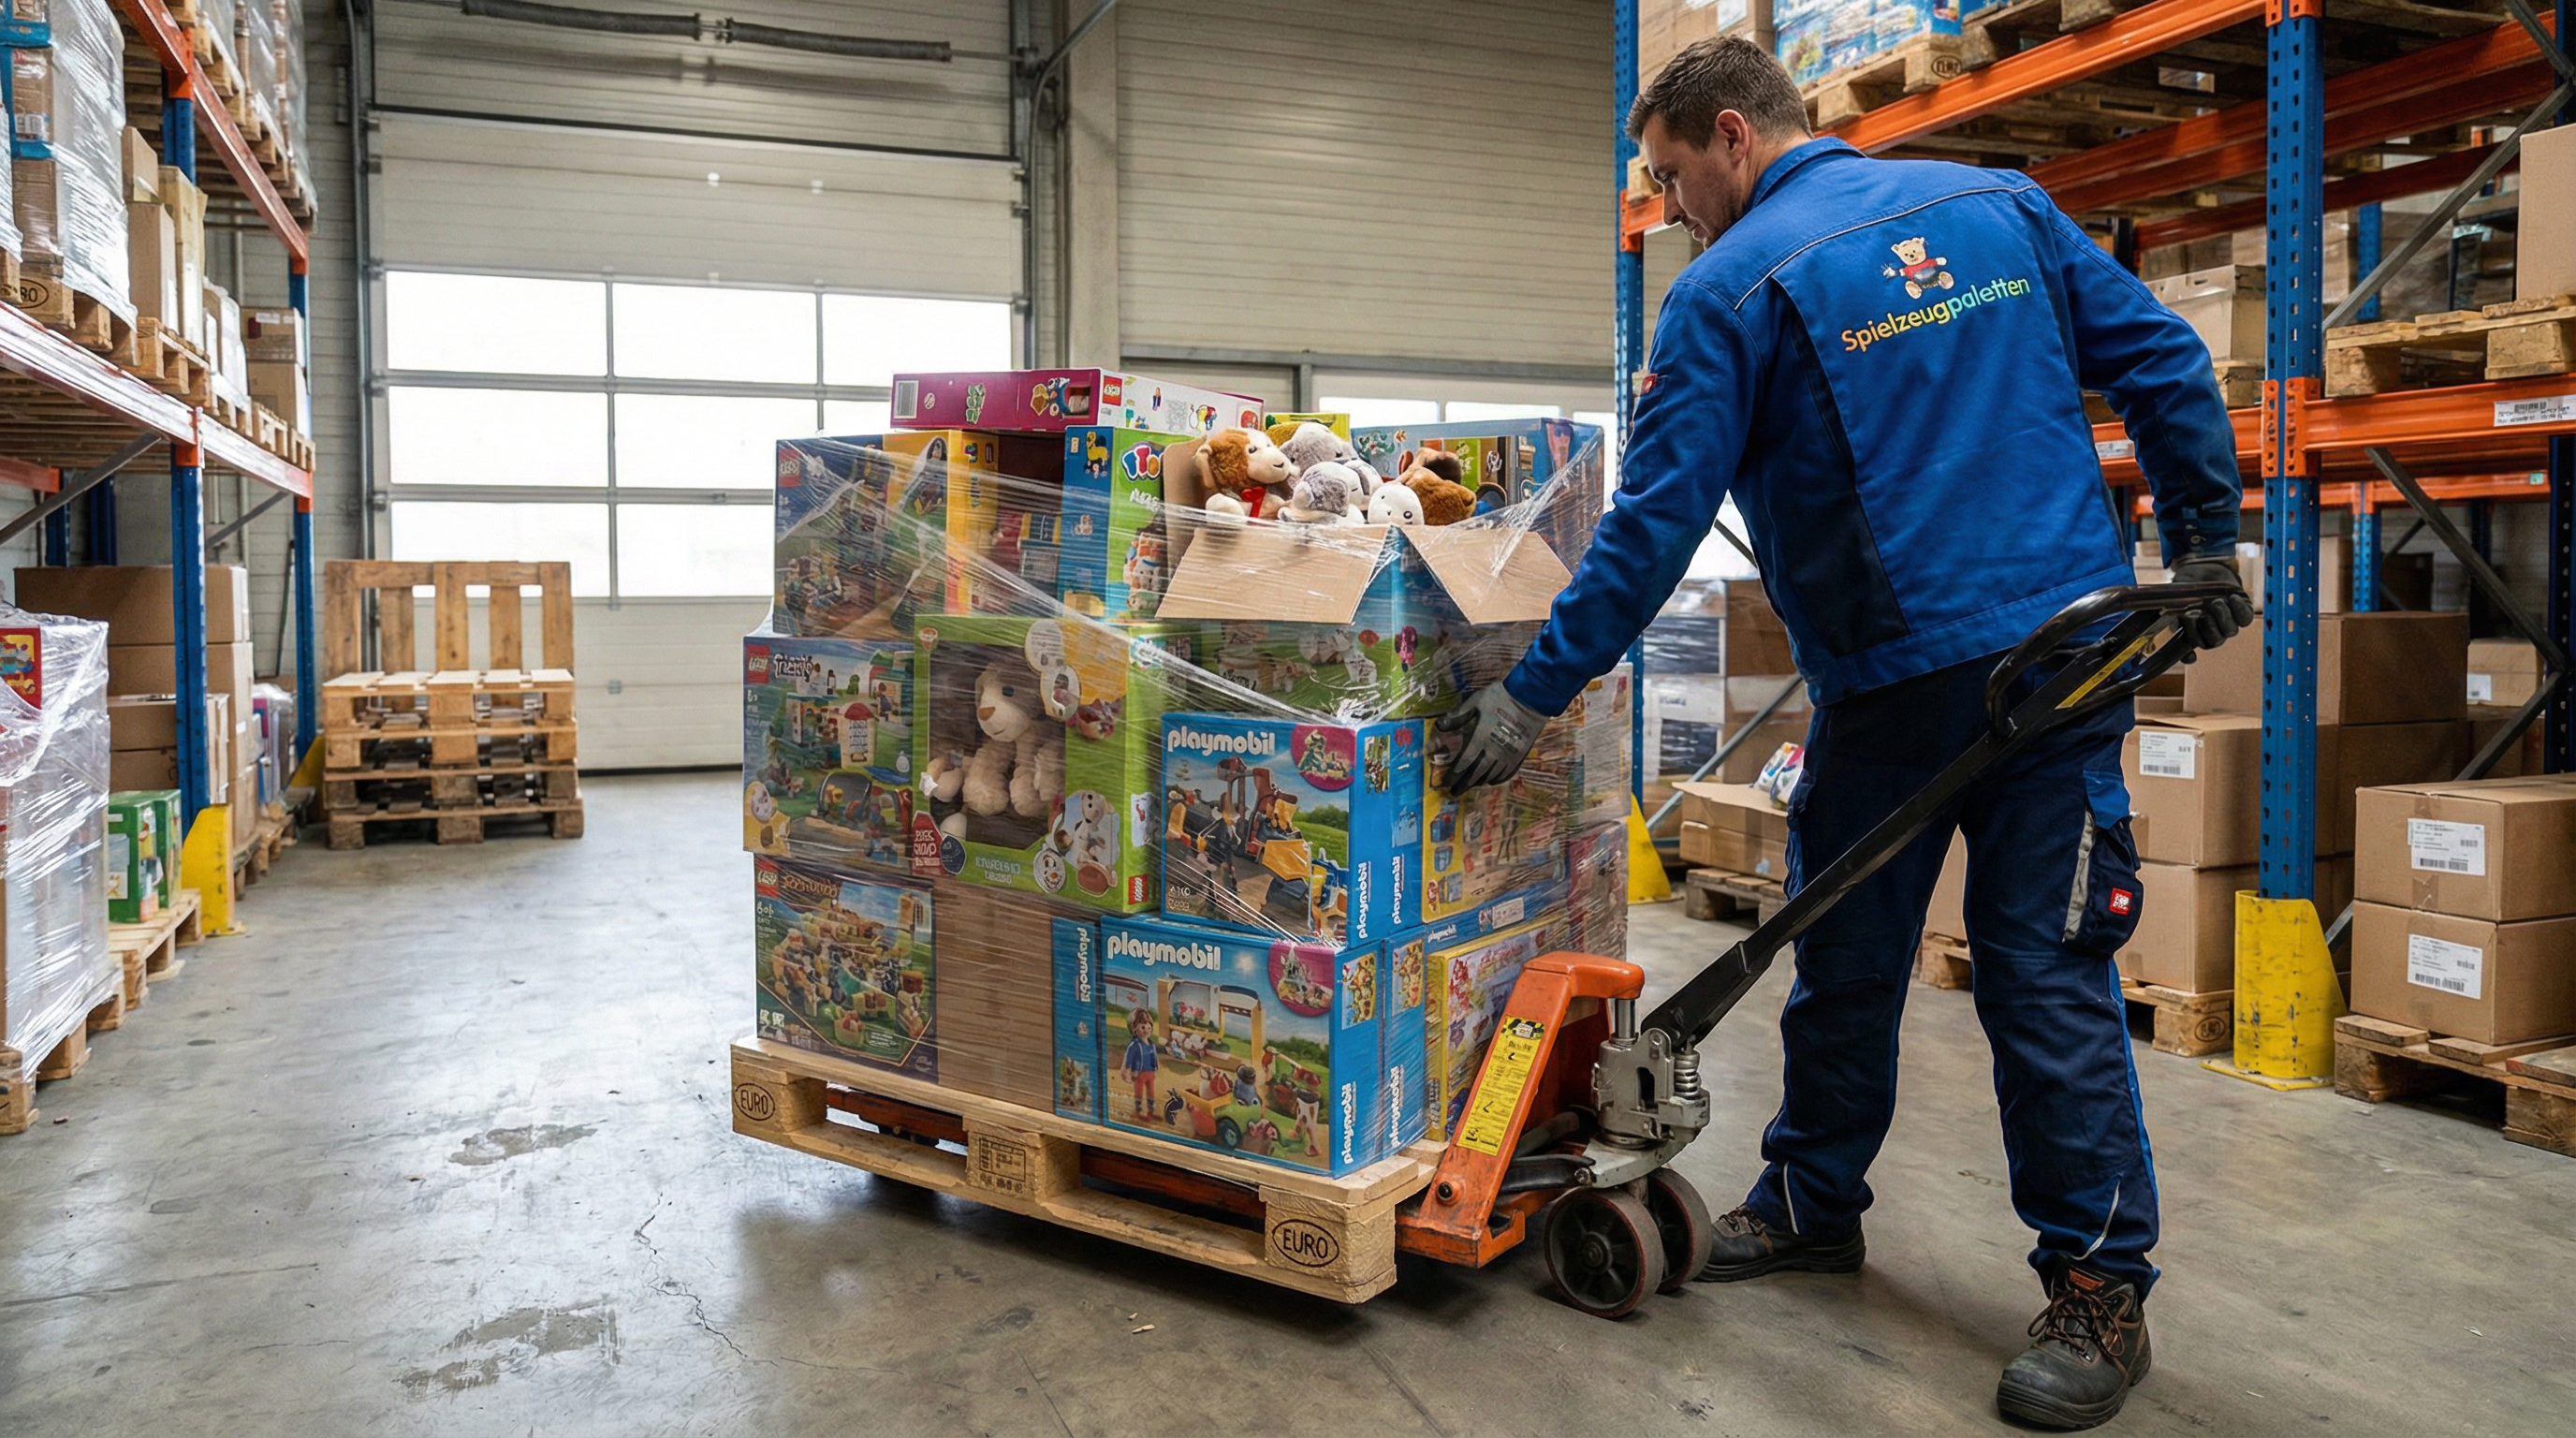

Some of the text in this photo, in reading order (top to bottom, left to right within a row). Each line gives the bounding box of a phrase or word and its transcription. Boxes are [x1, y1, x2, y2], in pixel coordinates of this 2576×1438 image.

[1841, 278, 2031, 352] Spielzeugpaletten
[1167, 726, 1276, 756] playmobil
[1356, 862, 1369, 939] playmobil
[1076, 927, 1091, 1003] playmobil
[1106, 931, 1222, 972] playmobil
[739, 1089, 768, 1115] EURO
[1340, 1082, 1354, 1165] playmobil
[1282, 1227, 1328, 1259] EURO
